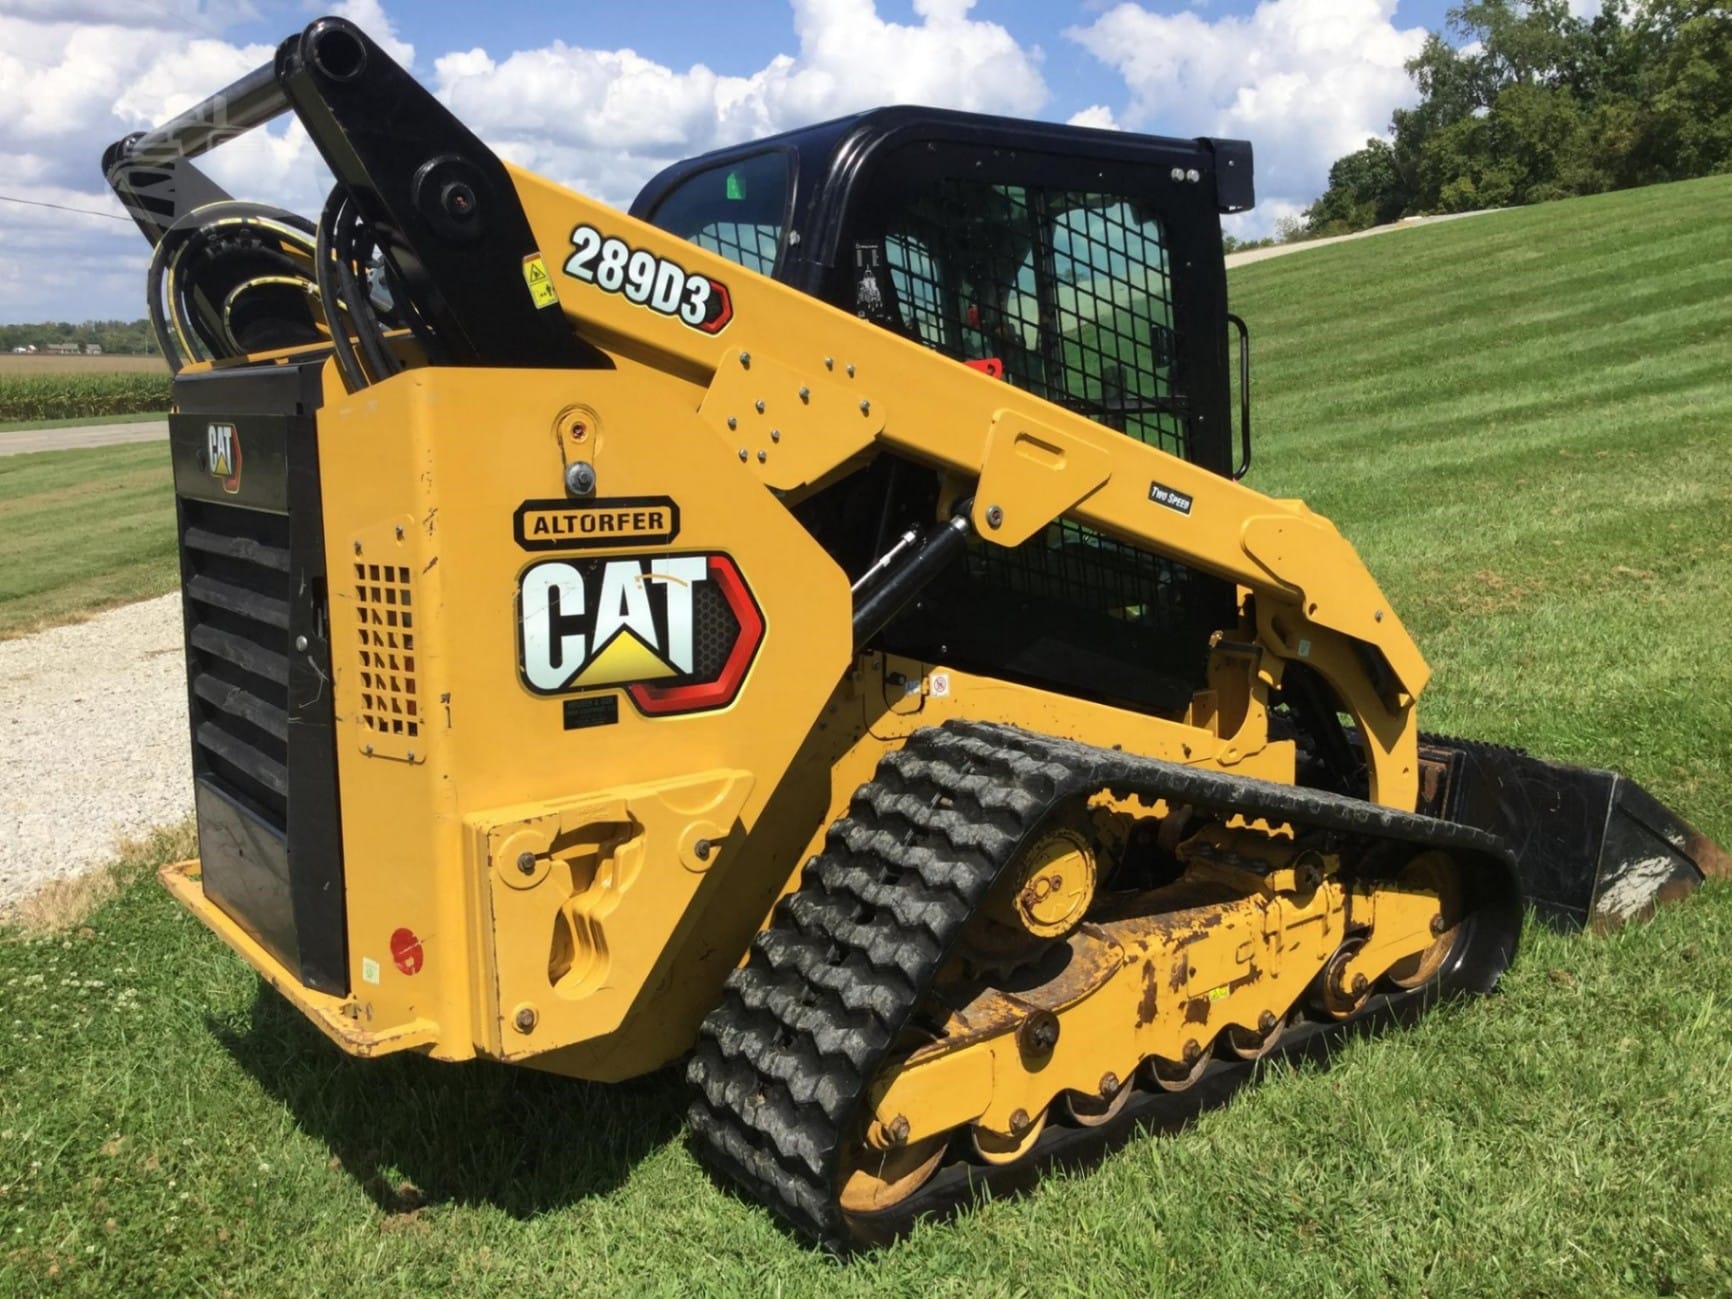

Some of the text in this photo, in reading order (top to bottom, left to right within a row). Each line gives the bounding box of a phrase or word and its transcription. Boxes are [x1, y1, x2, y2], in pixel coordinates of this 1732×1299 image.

[565, 226, 711, 324] 289D3
[208, 425, 231, 475] CAT
[533, 511, 664, 535] ALTORFER
[522, 556, 707, 690] CAT
